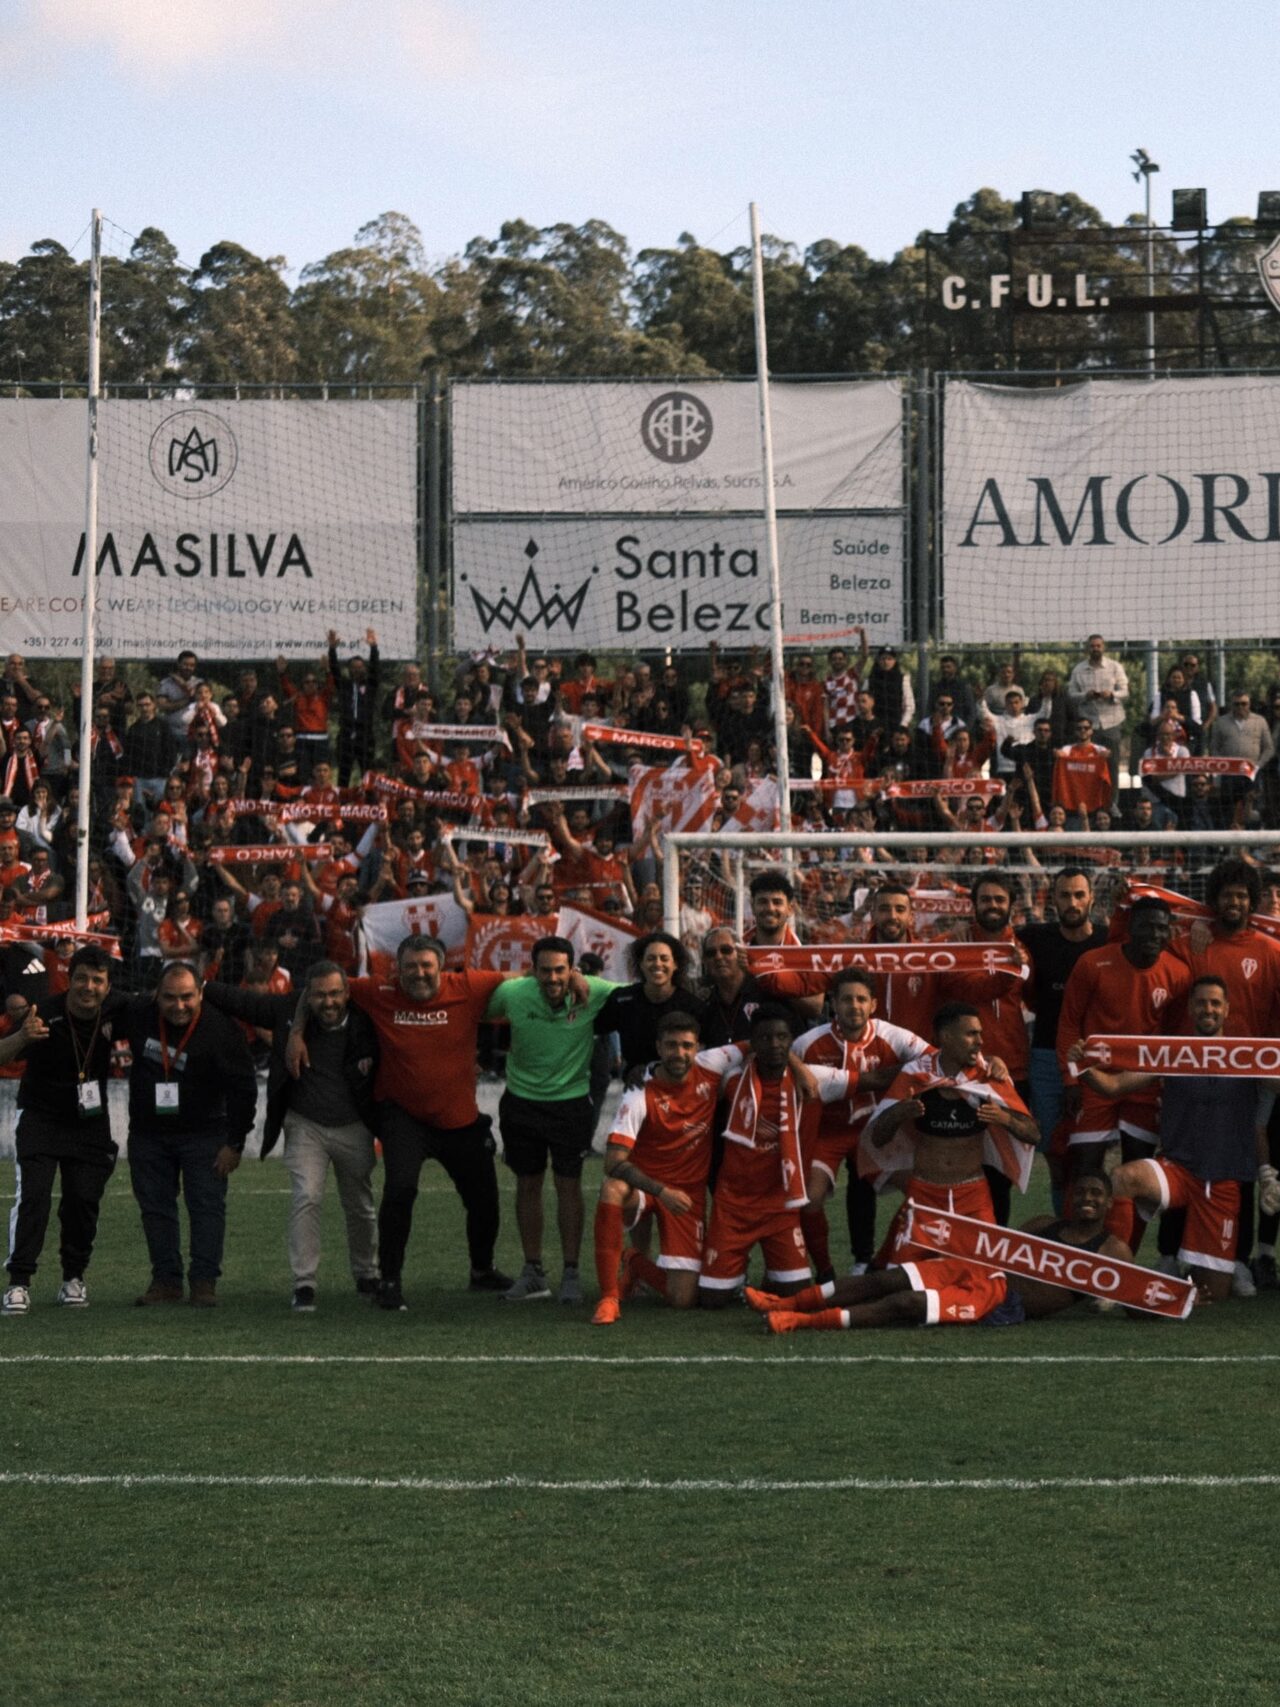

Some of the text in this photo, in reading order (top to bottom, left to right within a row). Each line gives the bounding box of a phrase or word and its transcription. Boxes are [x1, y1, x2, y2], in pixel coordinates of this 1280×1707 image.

[72, 533, 313, 578] MASILVA
[833, 537, 890, 556] Saúde
[615, 535, 759, 580] Santa
[830, 573, 891, 591] Beleza
[800, 608, 891, 626] Bem-estar
[611, 732, 676, 749] MARCO
[1166, 758, 1230, 773] MARCO
[339, 803, 388, 820] MARCO
[812, 950, 957, 973] MARCO
[394, 1010, 448, 1021] MARCO
[930, 1119, 976, 1131] CATAPULT
[974, 1231, 1122, 1293] MARCO
